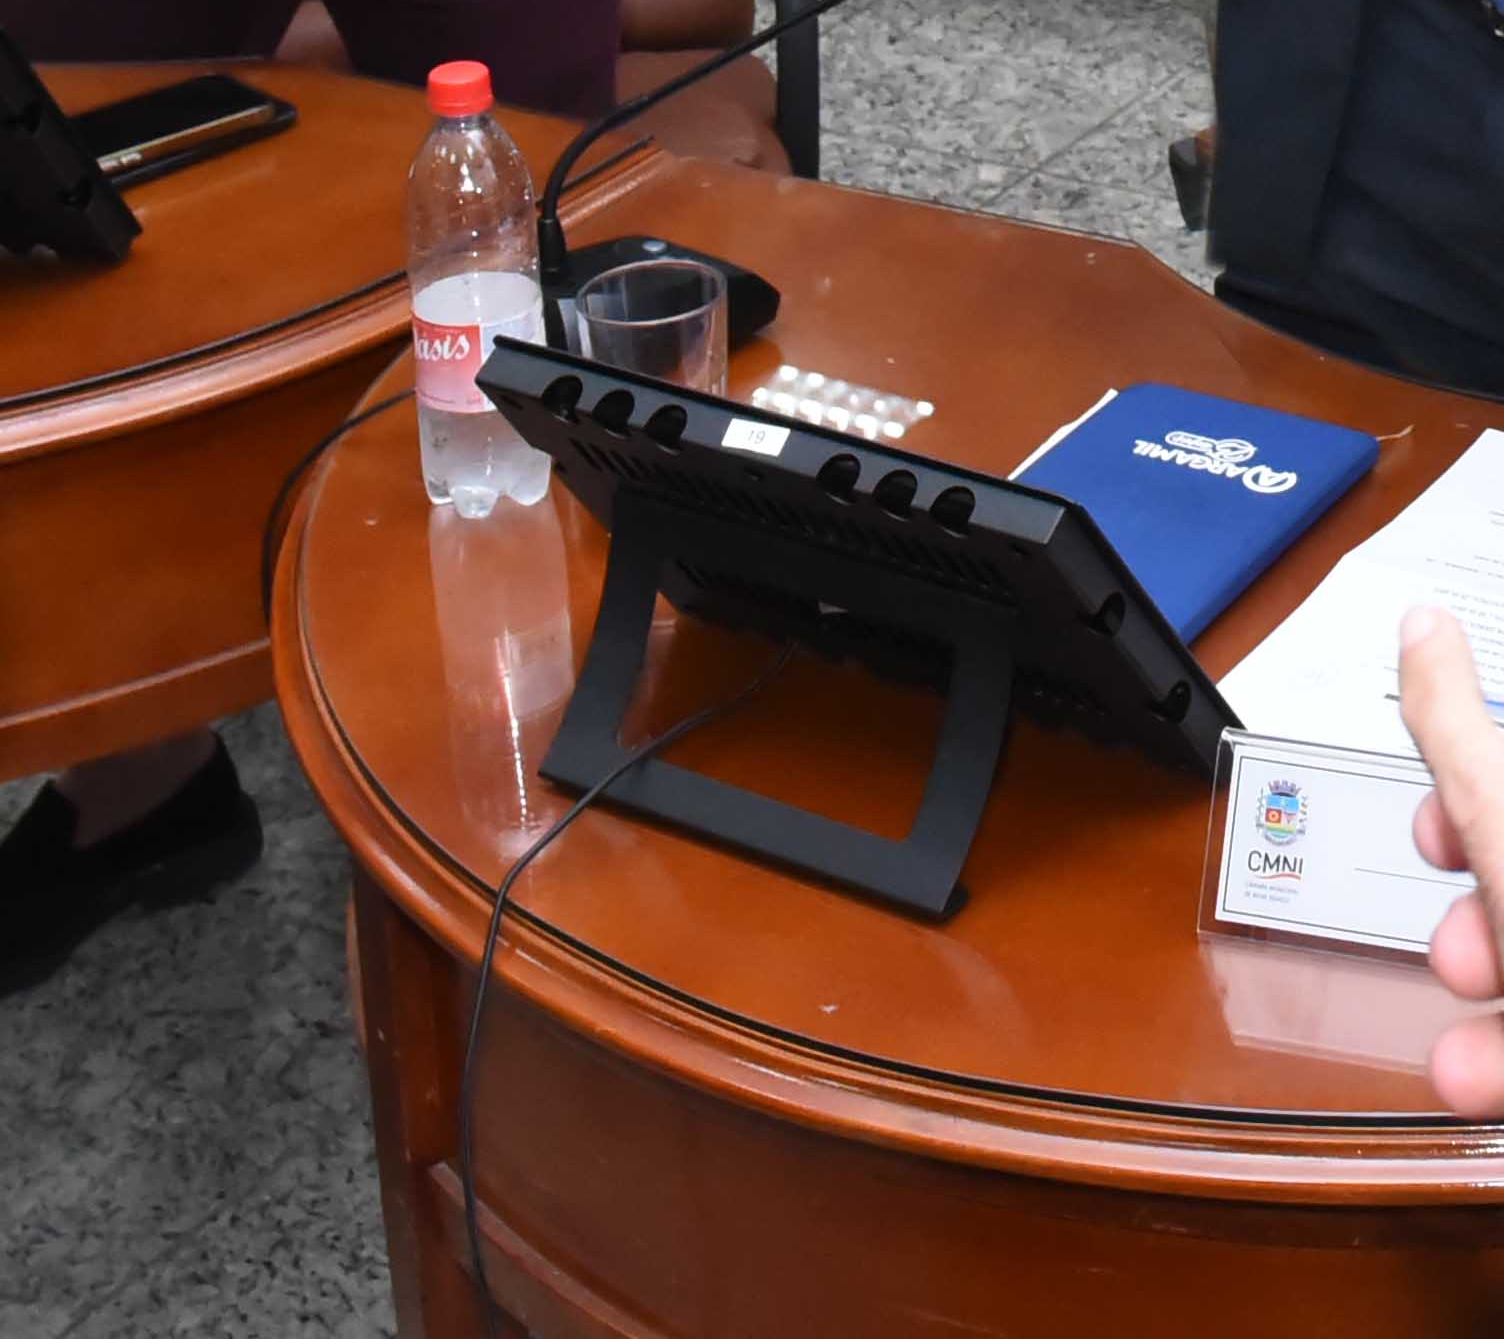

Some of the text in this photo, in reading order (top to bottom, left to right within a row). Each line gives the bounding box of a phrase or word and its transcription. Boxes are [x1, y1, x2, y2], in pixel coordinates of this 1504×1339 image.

[747, 430, 766, 444] 19
[1132, 440, 1249, 477] ARGAMIL
[1247, 850, 1303, 874] CMNI
